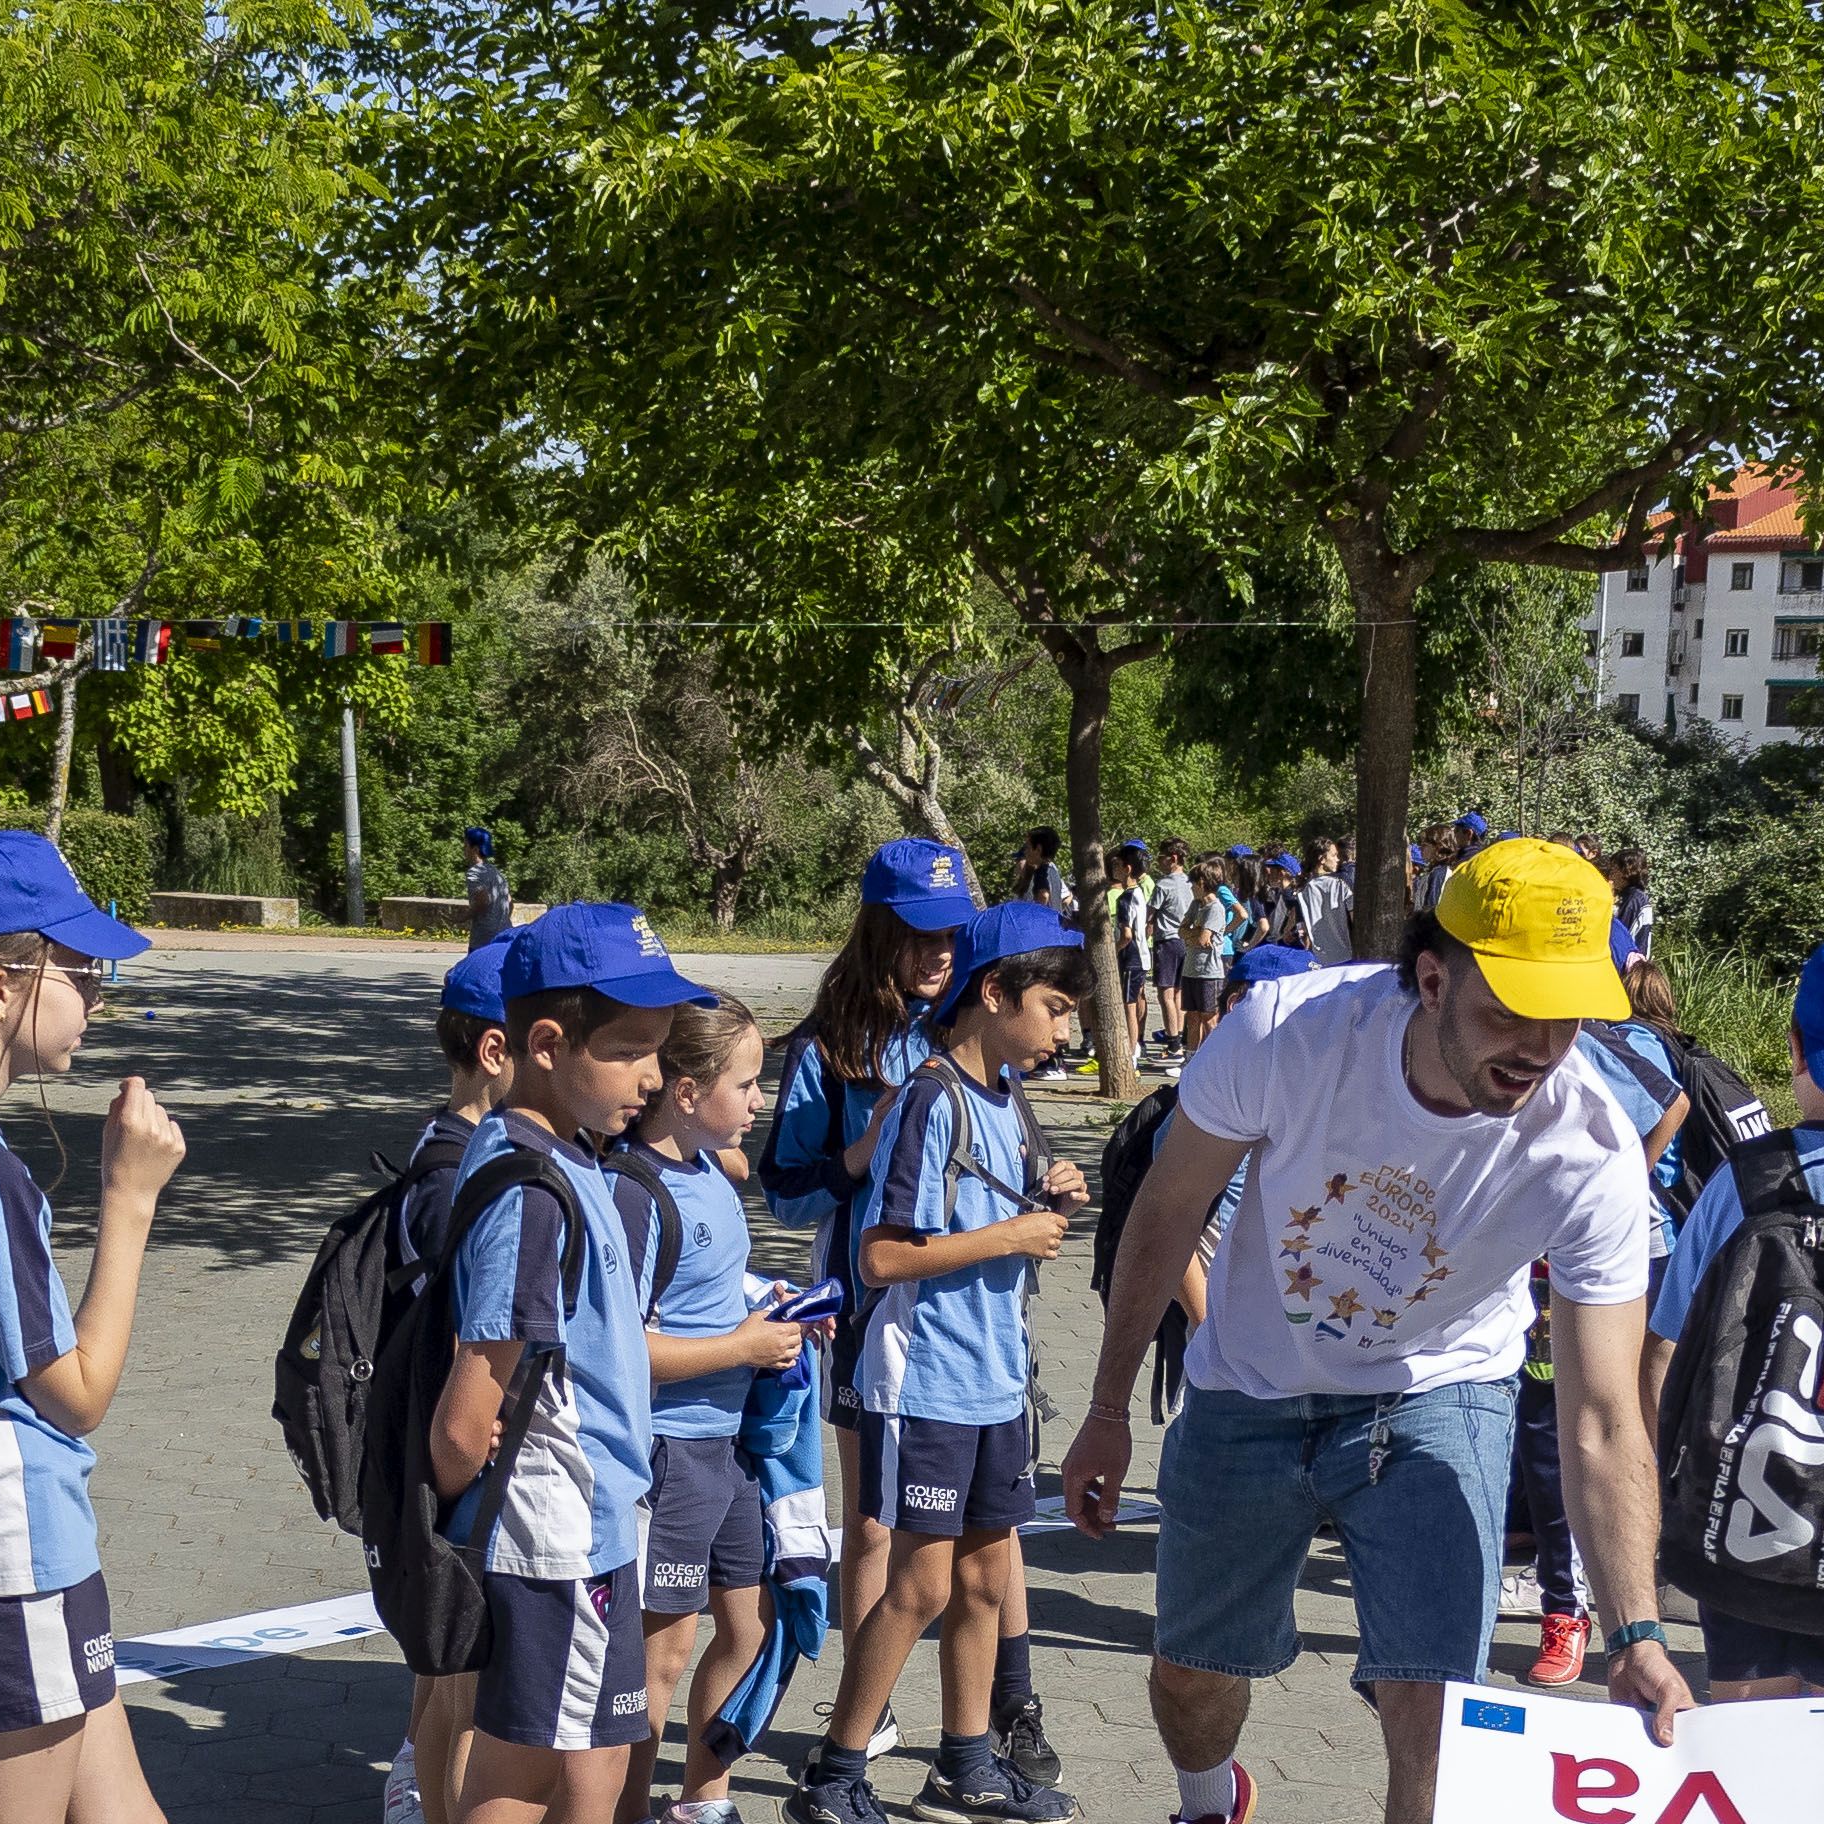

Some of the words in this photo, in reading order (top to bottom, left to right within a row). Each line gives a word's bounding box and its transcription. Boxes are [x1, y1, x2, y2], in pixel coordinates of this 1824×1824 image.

[1378, 1165, 1412, 1187] DÍA
[1359, 1171, 1437, 1227] EUROPA
[1366, 1195, 1414, 1234] 2024
[1351, 1236, 1371, 1256] en
[1379, 1251, 1393, 1270] la
[905, 1484, 958, 1502] COLEGIO
[1713, 1462, 1732, 1499] FILA
[905, 1495, 956, 1512] NAZARET
[1703, 1516, 1721, 1550] FILA
[653, 1575, 704, 1588] NAZARET
[654, 1563, 706, 1577] COLEGIO
